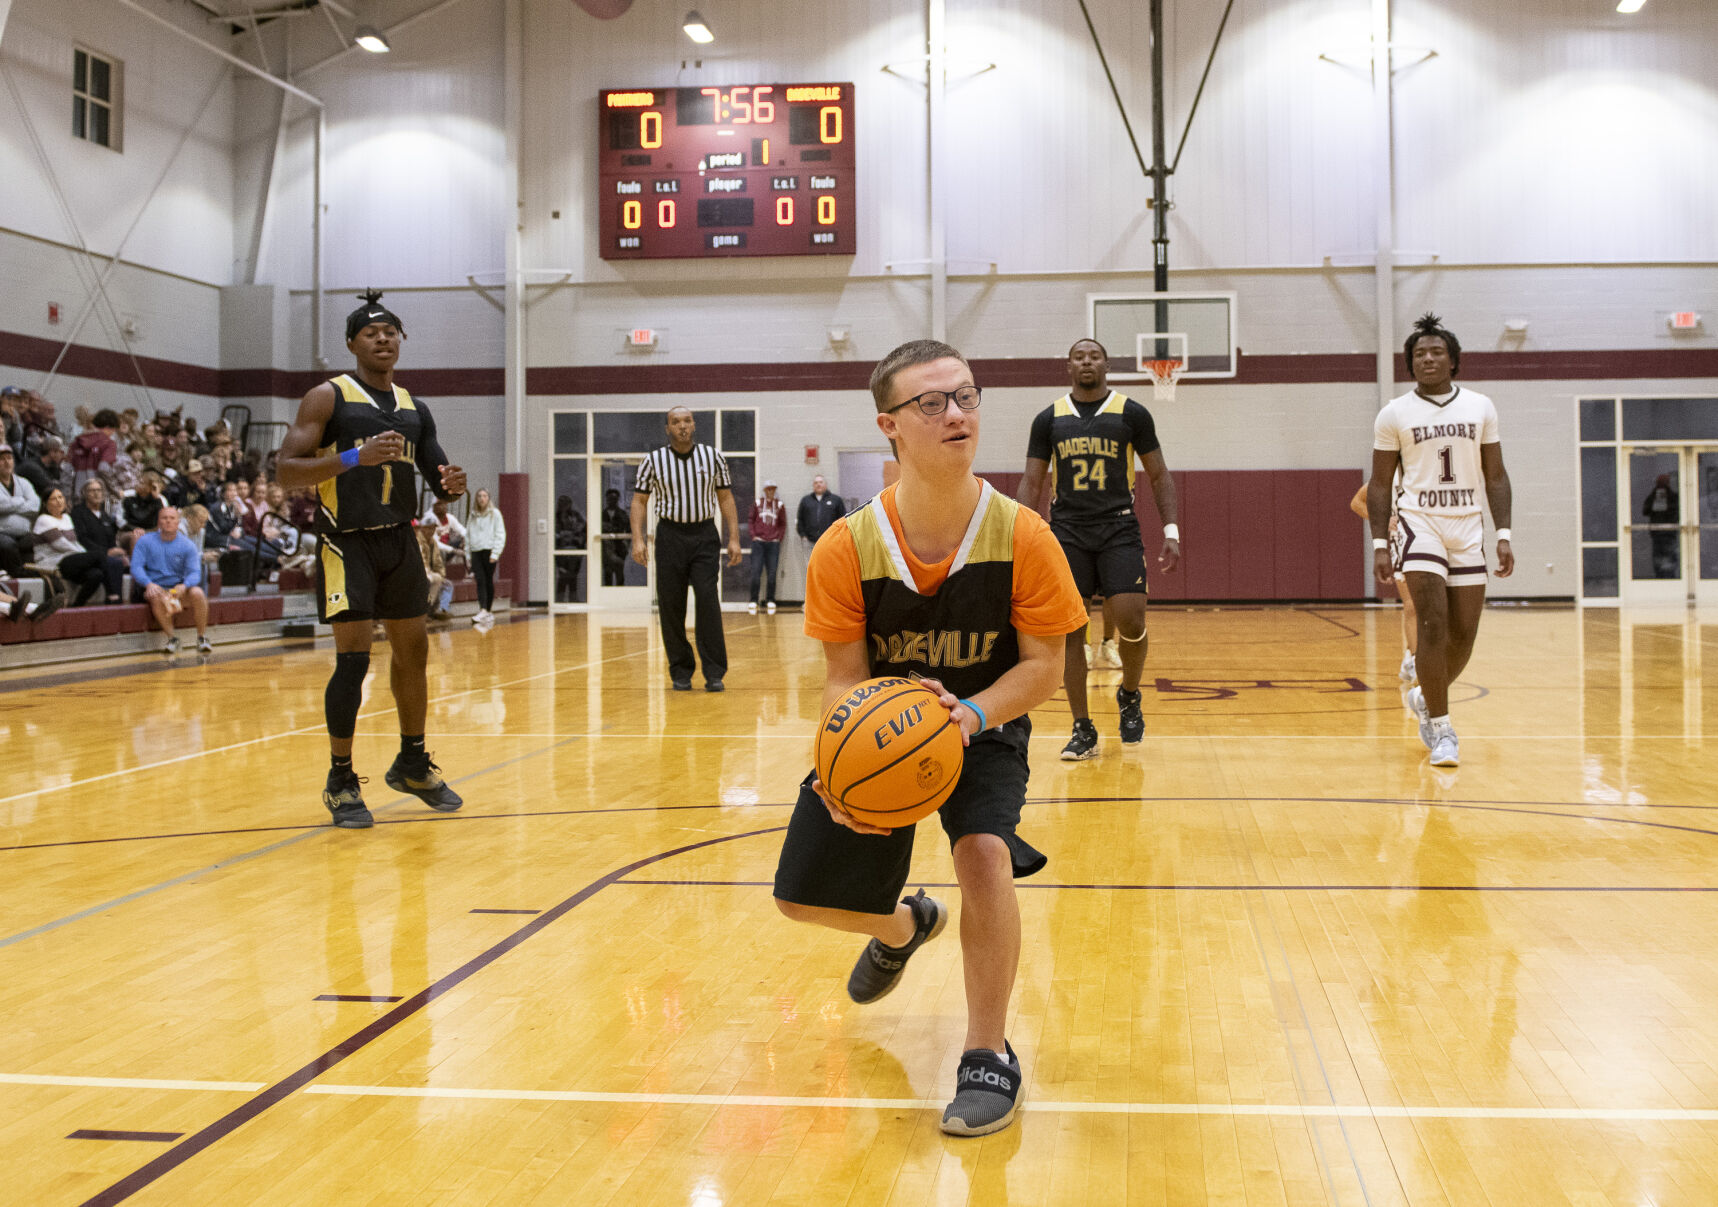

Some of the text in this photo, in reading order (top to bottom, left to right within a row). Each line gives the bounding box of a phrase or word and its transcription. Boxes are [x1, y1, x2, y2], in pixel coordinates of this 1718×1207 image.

[700, 86, 775, 124] 7:56
[640, 111, 662, 149] 0
[820, 106, 842, 144] 0
[762, 138, 769, 165] 1
[709, 177, 743, 193] player
[623, 200, 642, 229] 0
[658, 199, 677, 229] 0
[776, 195, 795, 226] 0
[817, 195, 837, 225] 0
[619, 237, 640, 248] won
[713, 235, 739, 249] game
[813, 232, 835, 244] won
[1057, 436, 1119, 460] DADEVILLE
[1411, 422, 1477, 446] ELMORE
[1071, 458, 1108, 491] 24
[1438, 445, 1457, 484] 1
[380, 464, 394, 505] 1
[1418, 488, 1476, 508] COUNTY
[874, 704, 923, 750] EVO
